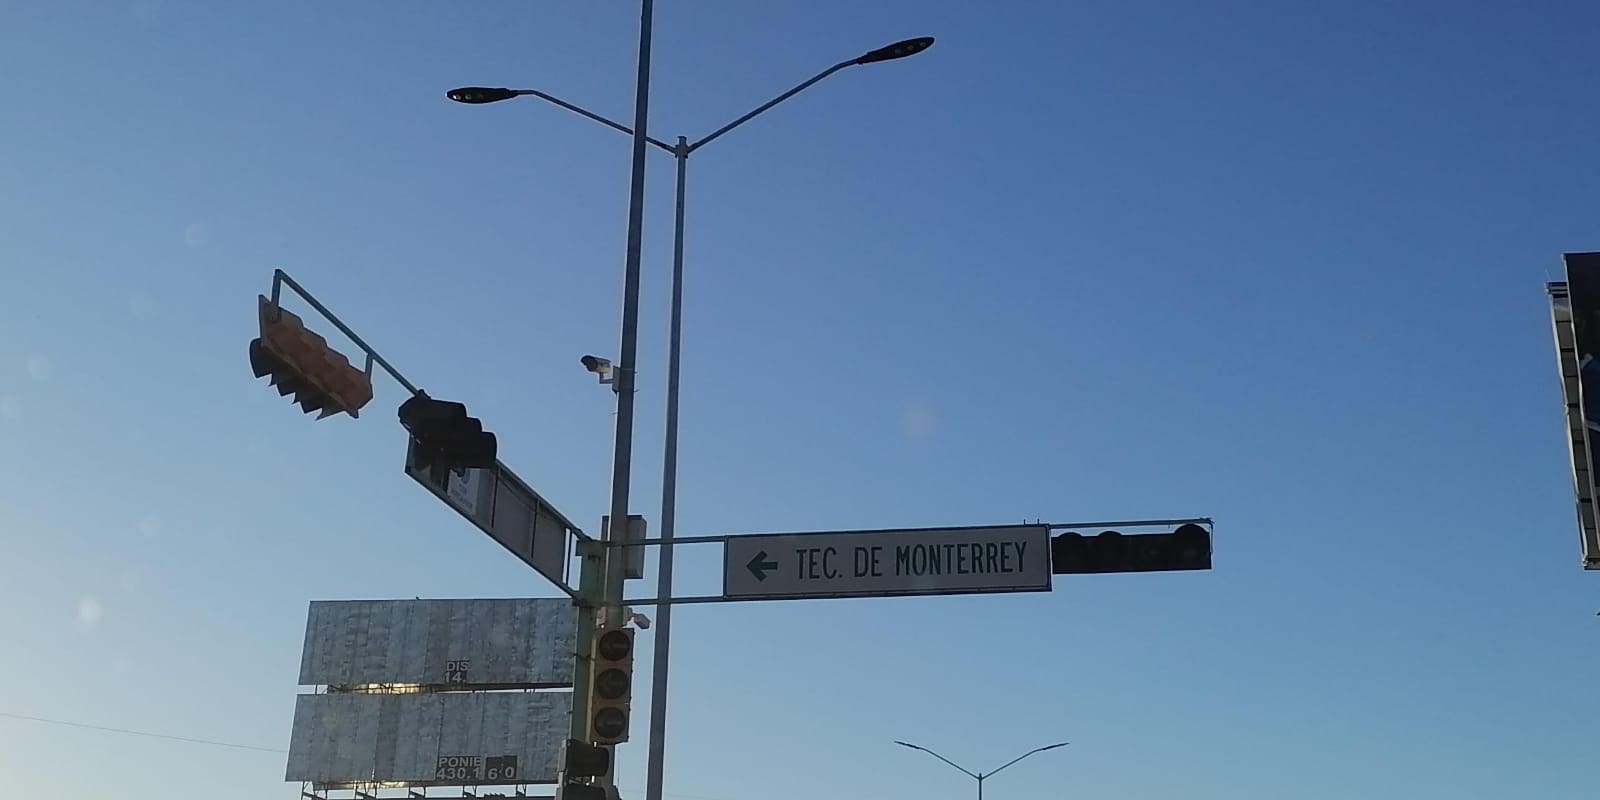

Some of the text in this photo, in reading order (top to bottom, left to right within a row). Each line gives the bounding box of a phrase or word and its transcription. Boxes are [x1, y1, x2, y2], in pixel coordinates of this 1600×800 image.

[796, 541, 1028, 580] TEC. DE MONTERREY
